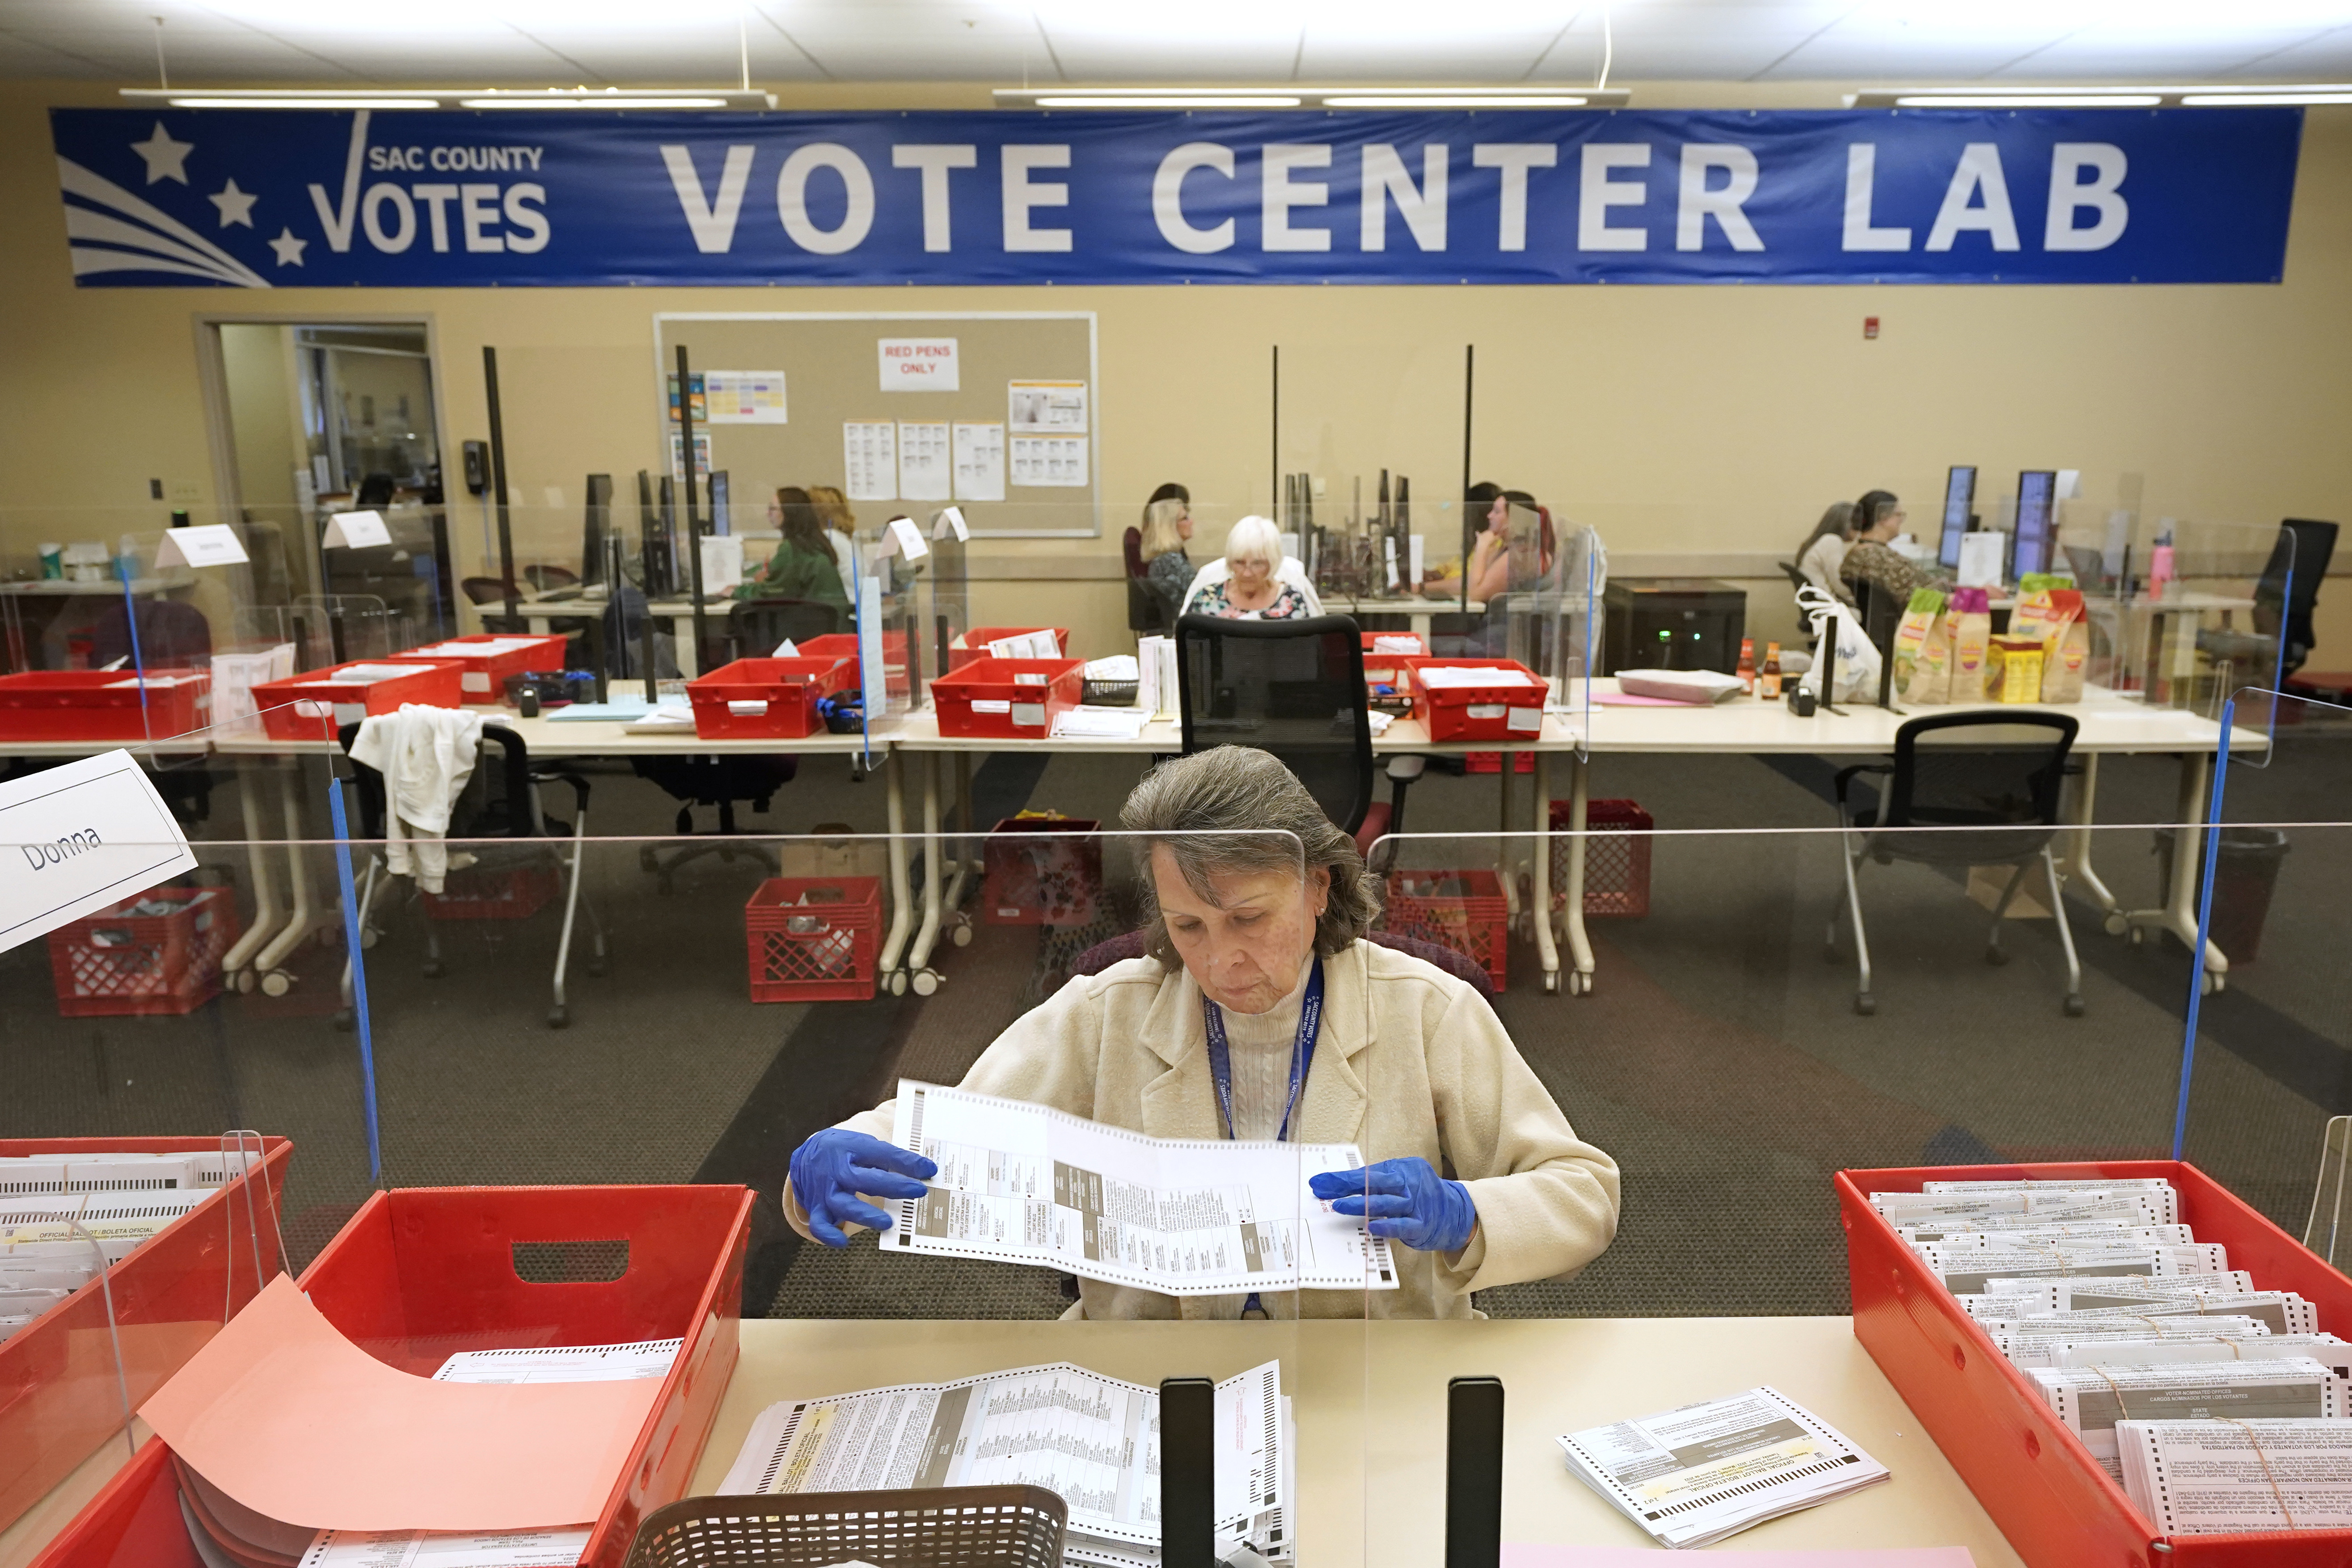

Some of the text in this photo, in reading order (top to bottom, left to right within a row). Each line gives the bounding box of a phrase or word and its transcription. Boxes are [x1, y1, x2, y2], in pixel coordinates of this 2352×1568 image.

[368, 146, 544, 172] SAC COUNTY
[659, 141, 2130, 255] VOTE CENTER LAB
[885, 345, 950, 357] RED PENS
[900, 362, 937, 374] ONLY
[21, 827, 102, 871] Donna
[959, 1437, 967, 1455] GOBERNADOR
[782, 1432, 811, 1485] BALLOT BOLETA OFICIAL
[1769, 1460, 1795, 1470] OFFICIAL
[1743, 1467, 1767, 1478] BALLOT
[1714, 1475, 1740, 1485] BOLETA
[1688, 1483, 1714, 1492] OFICIAL
